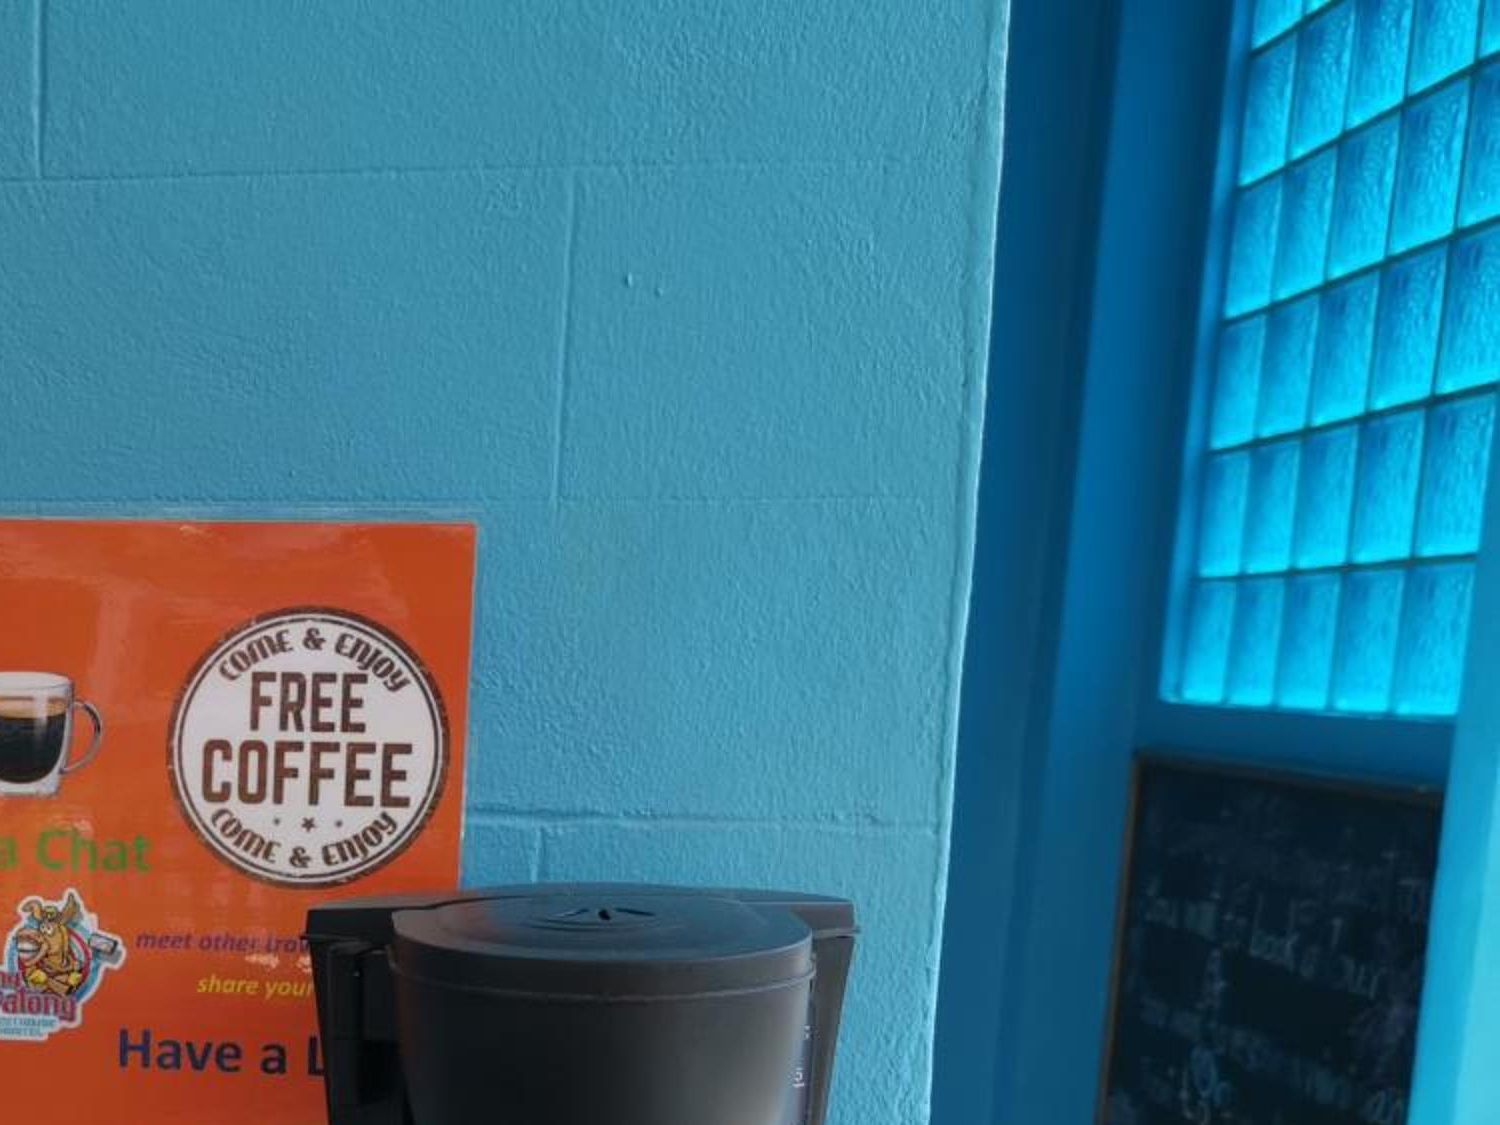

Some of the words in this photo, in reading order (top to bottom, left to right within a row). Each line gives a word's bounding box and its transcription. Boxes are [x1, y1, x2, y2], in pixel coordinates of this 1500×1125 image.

[217, 628, 295, 682] COME
[301, 626, 327, 652] &
[248, 670, 370, 734] FREE
[200, 737, 414, 809] COFFEE
[35, 829, 153, 873] Chat
[209, 807, 282, 865] COME
[287, 843, 312, 869] &
[135, 932, 194, 950] meet
[197, 931, 260, 952] other
[196, 974, 260, 996] share
[119, 1029, 243, 1074] Have
[260, 1042, 288, 1076] a
